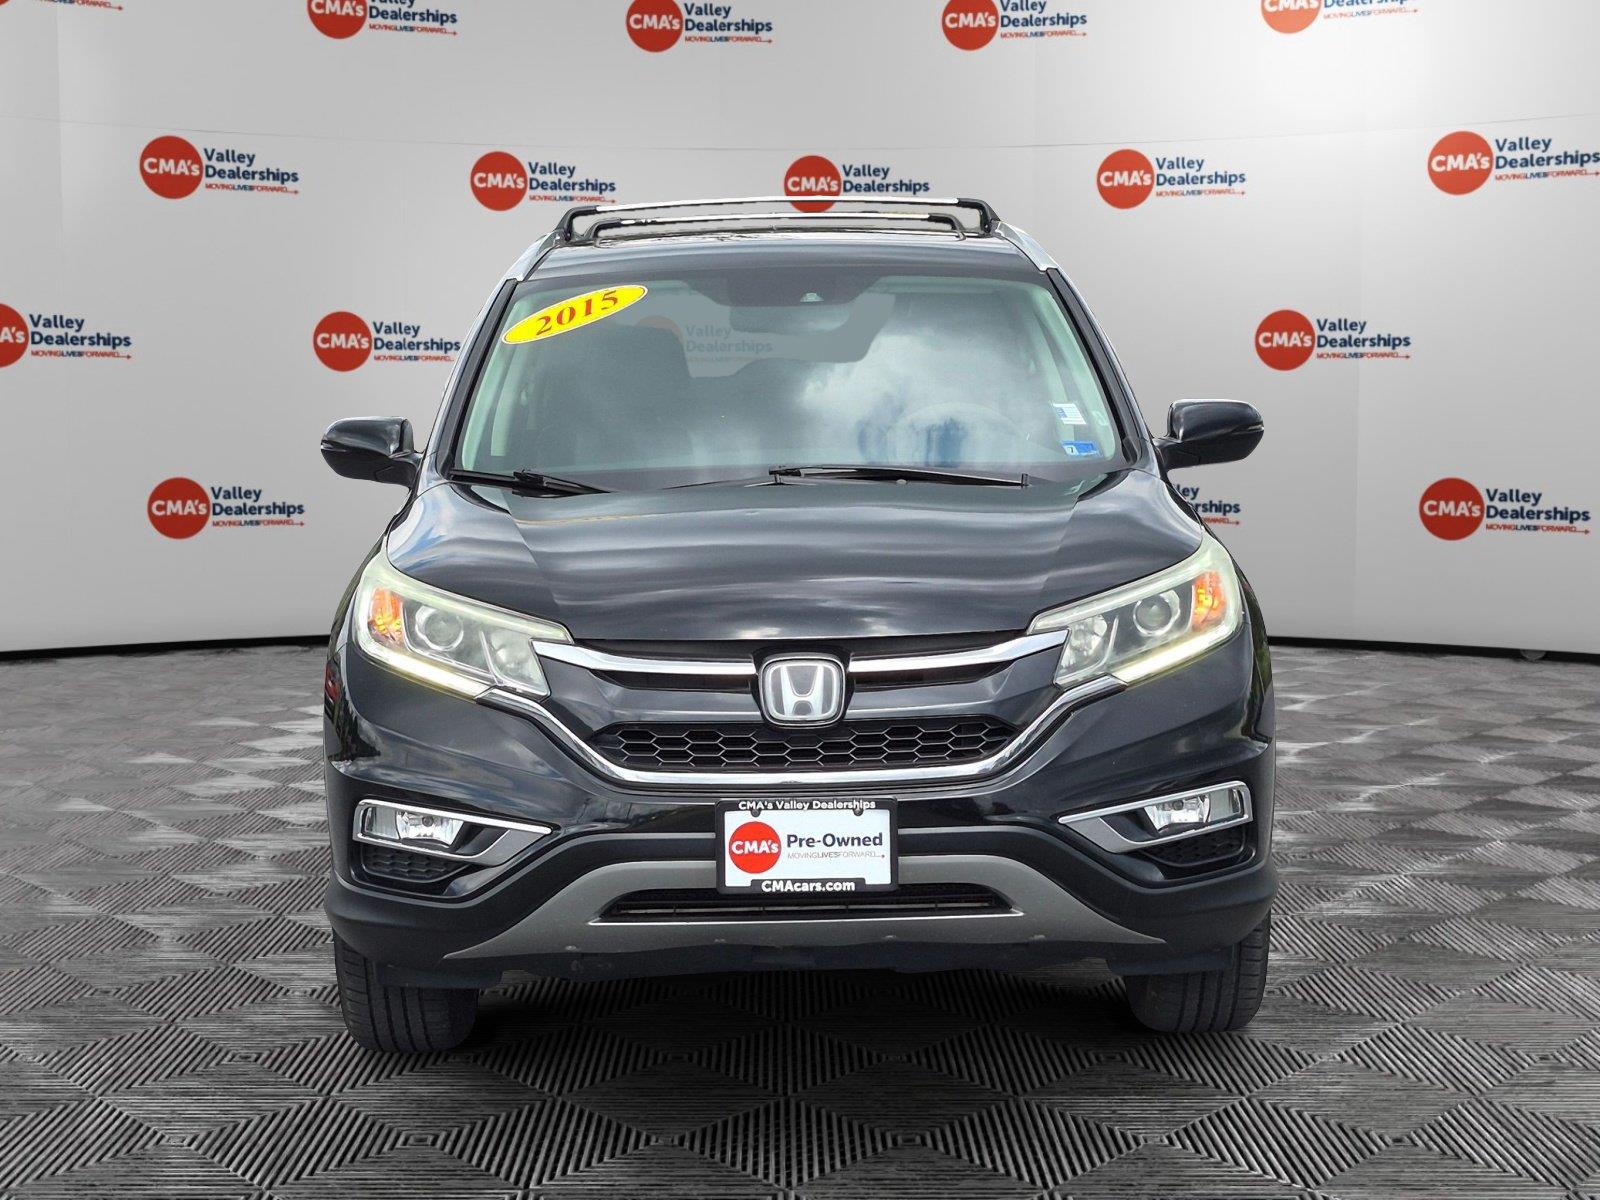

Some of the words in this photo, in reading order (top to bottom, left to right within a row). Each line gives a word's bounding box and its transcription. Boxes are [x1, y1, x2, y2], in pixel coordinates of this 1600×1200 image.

[311, 0, 364, 17] CMA's
[684, 3, 731, 19] Valley
[1000, 0, 1047, 14] Valley
[369, 6, 458, 25] Dealerships
[629, 13, 680, 30] CMA's
[945, 12, 996, 28] CMA's
[1000, 13, 1087, 28] Dealerships
[685, 18, 773, 35] Dealerships
[1495, 137, 1552, 153] Valley
[204, 148, 255, 167] Valley
[1155, 157, 1205, 172] Valley
[1431, 153, 1490, 172] CMA's
[1495, 150, 1600, 169] Dealerships
[143, 157, 200, 176] CMA's
[205, 165, 299, 184] Dealerships
[528, 162, 576, 178] Valley
[842, 164, 890, 180] Valley
[473, 172, 525, 189] CMA's
[529, 178, 616, 194] Dealerships
[787, 176, 838, 192] CMA's
[1100, 170, 1152, 187] CMA's
[1156, 171, 1246, 186] Dealerships
[843, 180, 930, 195] Dealerships
[536, 290, 618, 336] 2015
[29, 314, 85, 332] Valley
[373, 321, 420, 337] Valley
[1316, 318, 1367, 334] Valley
[0, 327, 25, 343] A's
[30, 331, 132, 349] Dealerships
[317, 333, 369, 349] CMA's
[1258, 331, 1312, 347] CMA's
[1317, 333, 1411, 350] Dealerships
[374, 337, 461, 354] Dealerships
[211, 486, 262, 502] Valley
[1486, 488, 1542, 506] Valley
[152, 499, 207, 516] CMA's
[212, 502, 305, 518] Dealerships
[1194, 500, 1241, 516] rships
[1423, 500, 1481, 517] CMA's
[1486, 505, 1590, 524] Dealerships
[739, 801, 773, 810] CMA's
[775, 800, 809, 810] Valley
[813, 800, 876, 811] Dealerships
[732, 840, 779, 855] CMA's
[786, 832, 883, 848] Pre-Owned
[761, 880, 856, 892] CMAcars.com
